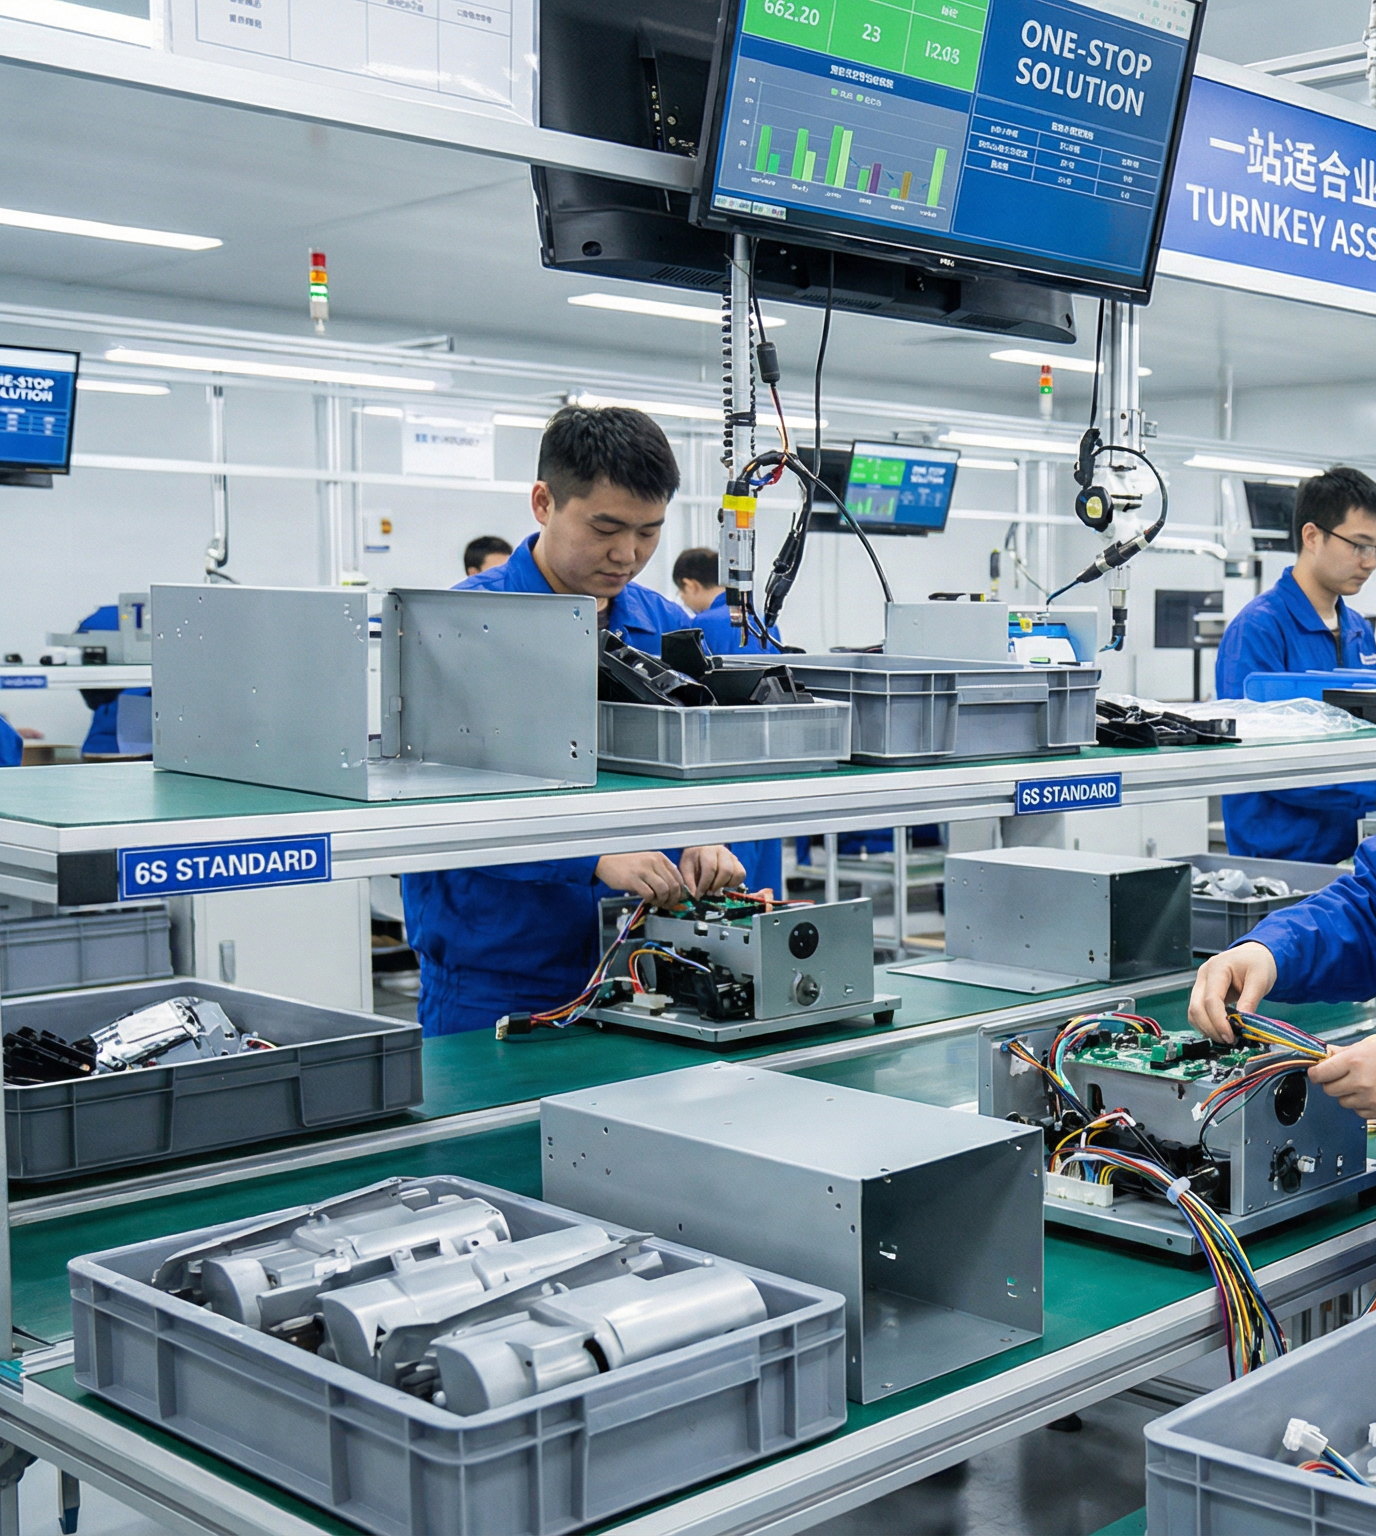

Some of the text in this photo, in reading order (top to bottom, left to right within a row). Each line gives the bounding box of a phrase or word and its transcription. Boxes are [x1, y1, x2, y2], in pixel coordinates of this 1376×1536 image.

[764, 0, 820, 26] 662.20
[861, 23, 882, 42] 23
[1021, 19, 1153, 79] ONE-STOP
[1015, 57, 1145, 117] SOLUTION
[1185, 182, 1326, 248] TURNKEY
[1022, 782, 1117, 806] 6S STANDARD
[134, 848, 318, 886] 6S STANDARD
